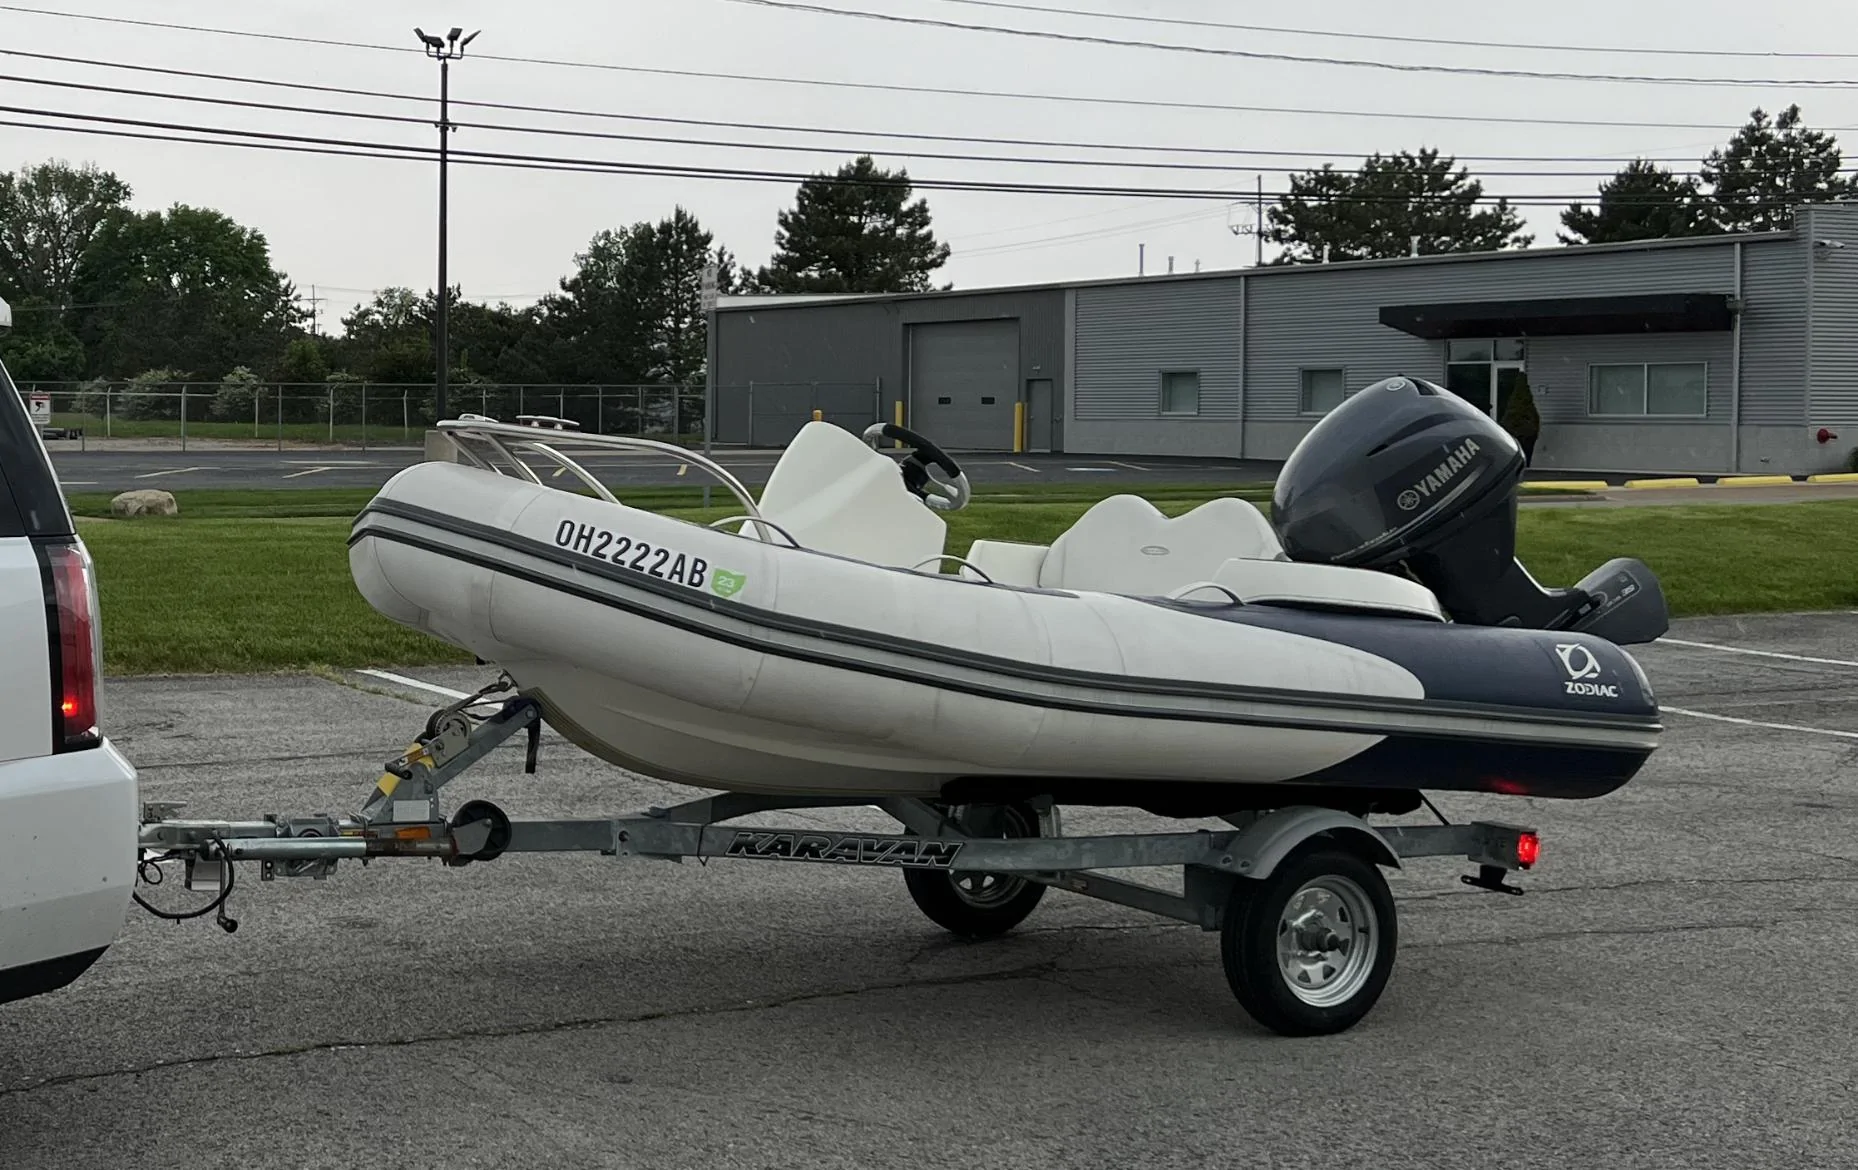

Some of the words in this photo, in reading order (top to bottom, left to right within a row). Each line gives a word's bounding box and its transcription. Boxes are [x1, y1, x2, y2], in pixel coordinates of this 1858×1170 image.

[1414, 438, 1480, 497] YAMAHA
[555, 519, 708, 588] OH2222AB
[717, 575, 735, 588] 23
[1564, 681, 1619, 697] ZODIAC
[725, 832, 965, 867] KARAVAN
